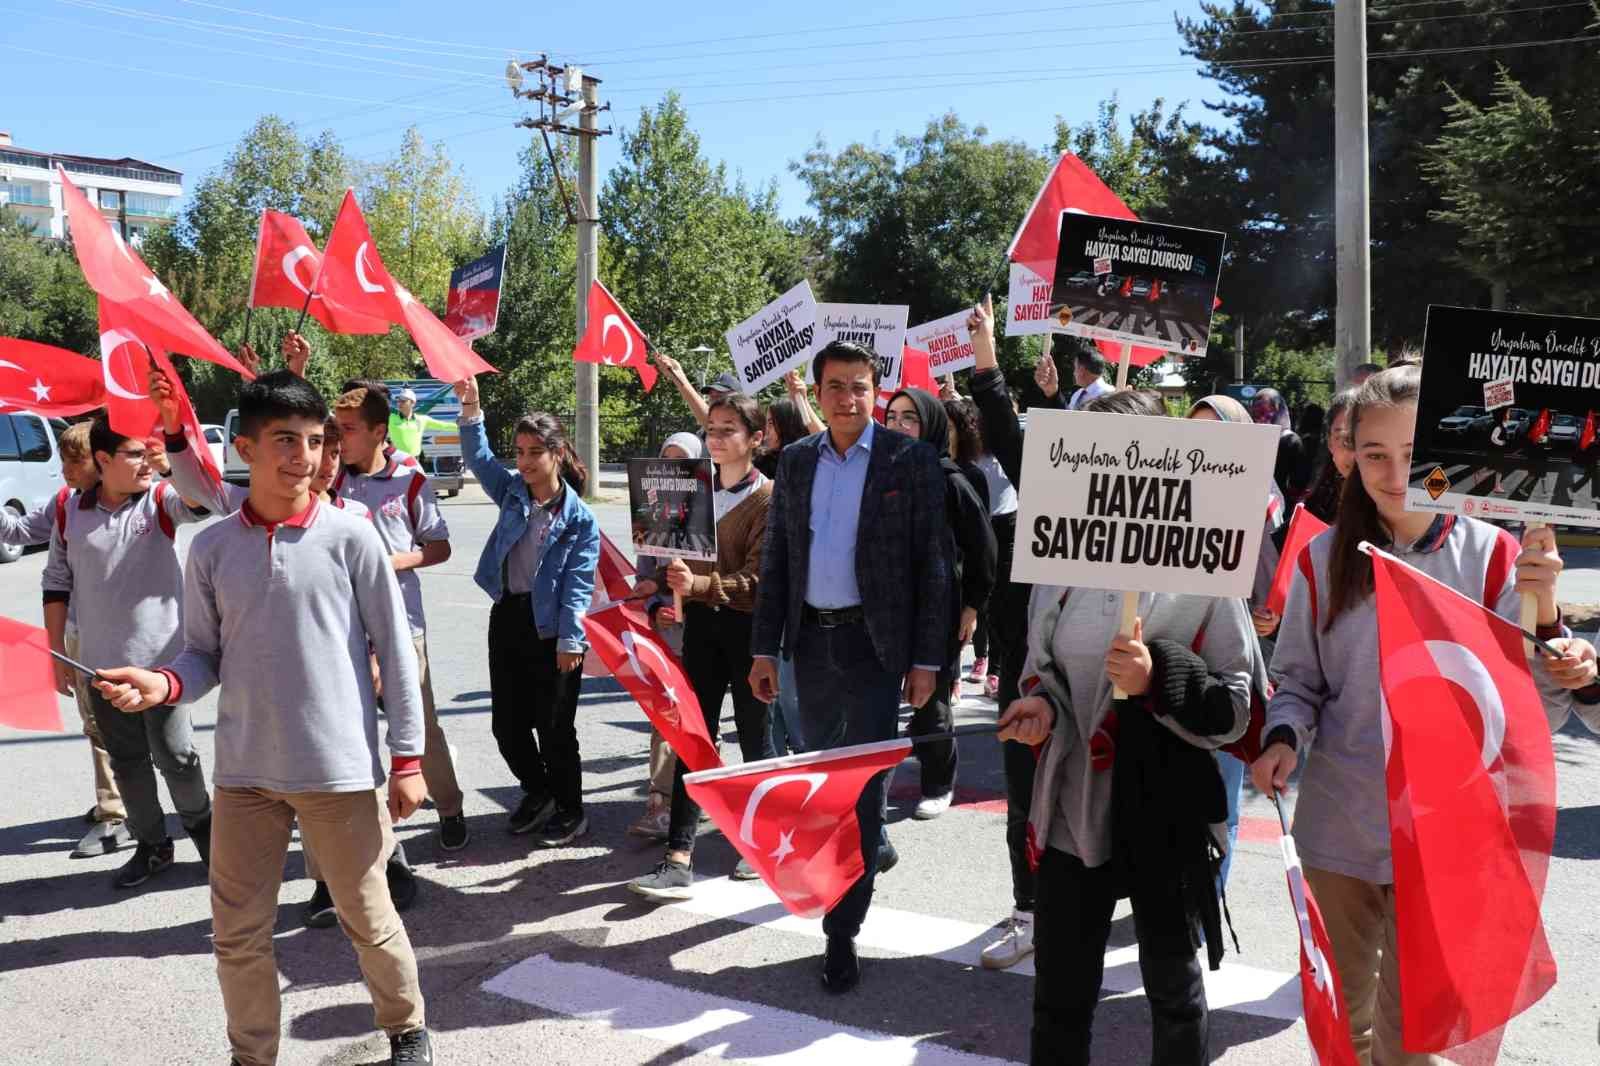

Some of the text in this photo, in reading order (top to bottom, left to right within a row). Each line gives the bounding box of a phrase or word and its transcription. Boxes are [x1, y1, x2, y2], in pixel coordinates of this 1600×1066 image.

[1085, 240, 1193, 272] HAYATA SAYGI DURUŞU
[1033, 284, 1052, 302] HAY
[1015, 303, 1043, 321] SAYGI
[755, 319, 795, 356] HAYATA
[928, 334, 958, 354] HAYATA
[744, 352, 777, 384] SAYGI
[1468, 352, 1527, 383] HAYATA
[1530, 357, 1580, 387] SAYGI
[1050, 437, 1248, 479] Yayalara Öncelik Duruşu
[1086, 472, 1193, 523] HAYATA
[1031, 515, 1245, 574] SAYGI DURUŞU
